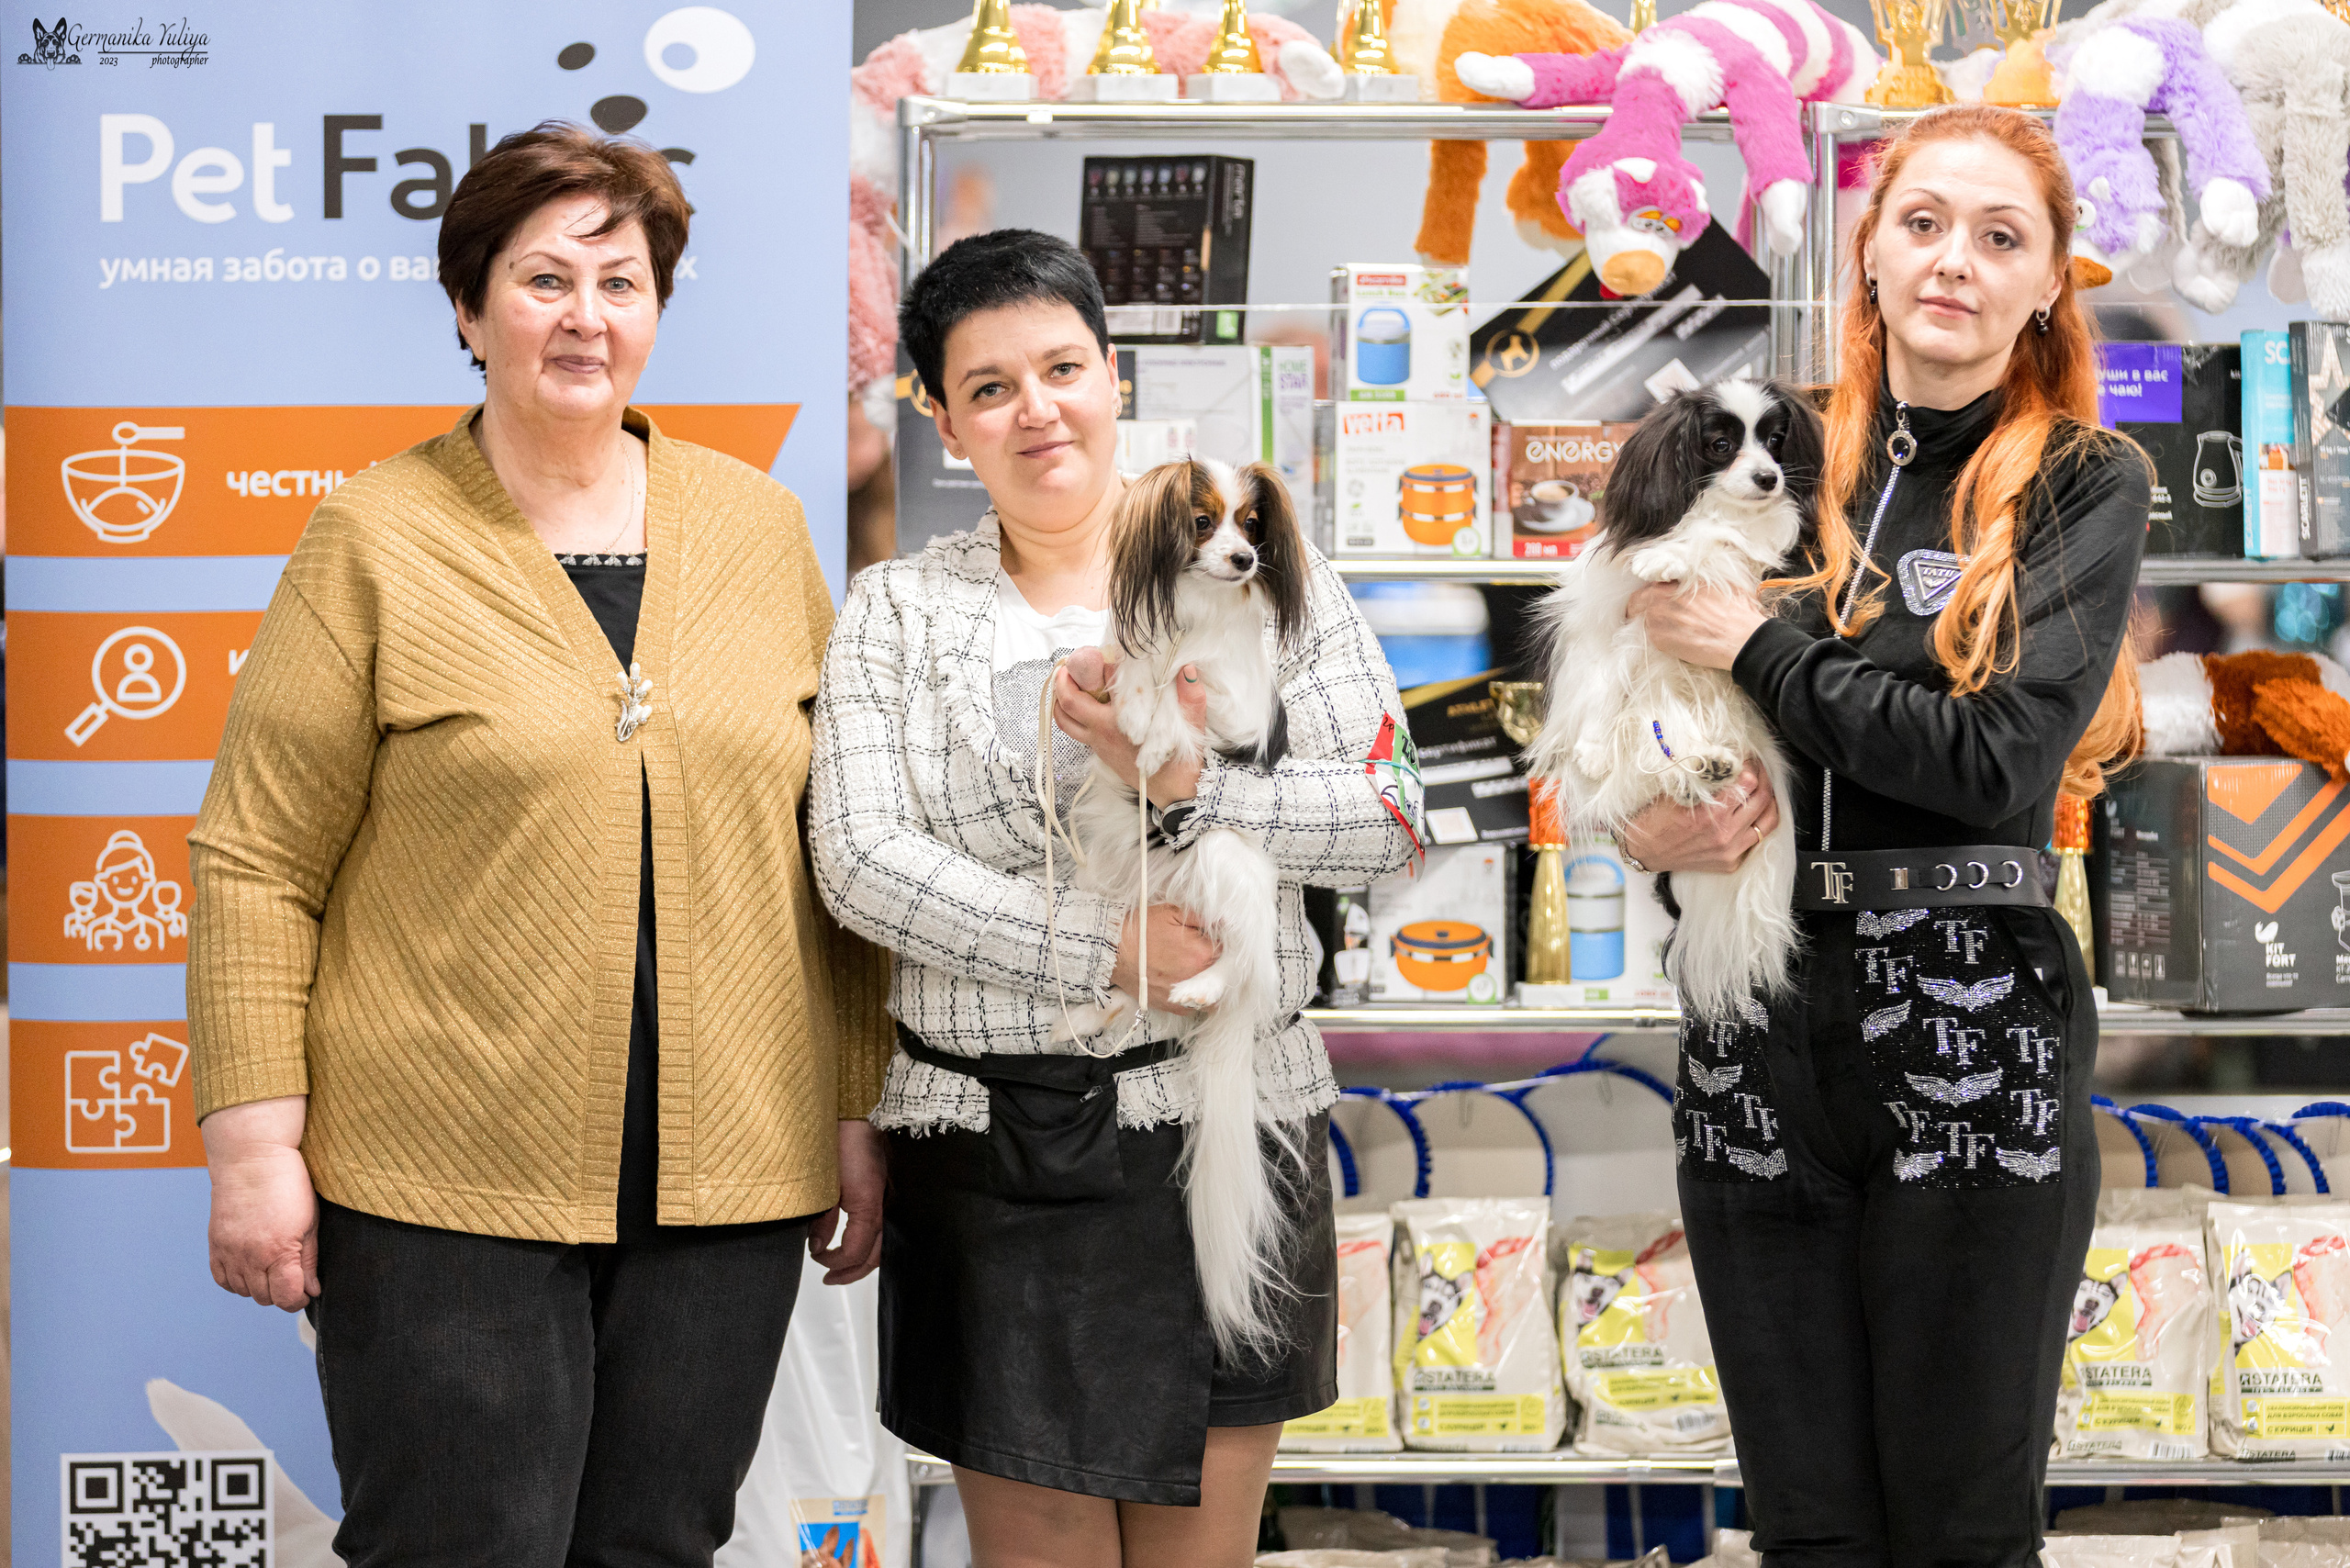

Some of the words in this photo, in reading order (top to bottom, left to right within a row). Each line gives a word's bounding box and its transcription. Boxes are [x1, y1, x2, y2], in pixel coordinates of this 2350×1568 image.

[99, 114, 296, 223] Pet
[98, 256, 215, 289] умная
[222, 247, 348, 282] забота
[357, 255, 382, 282] о
[226, 461, 378, 498] честн
[1810, 861, 1853, 904] TF
[2265, 942, 2285, 955] KIT
[2265, 953, 2297, 969] FORT
[2085, 1365, 2152, 1379] STATERA
[2251, 1372, 2322, 1385] STATERA
